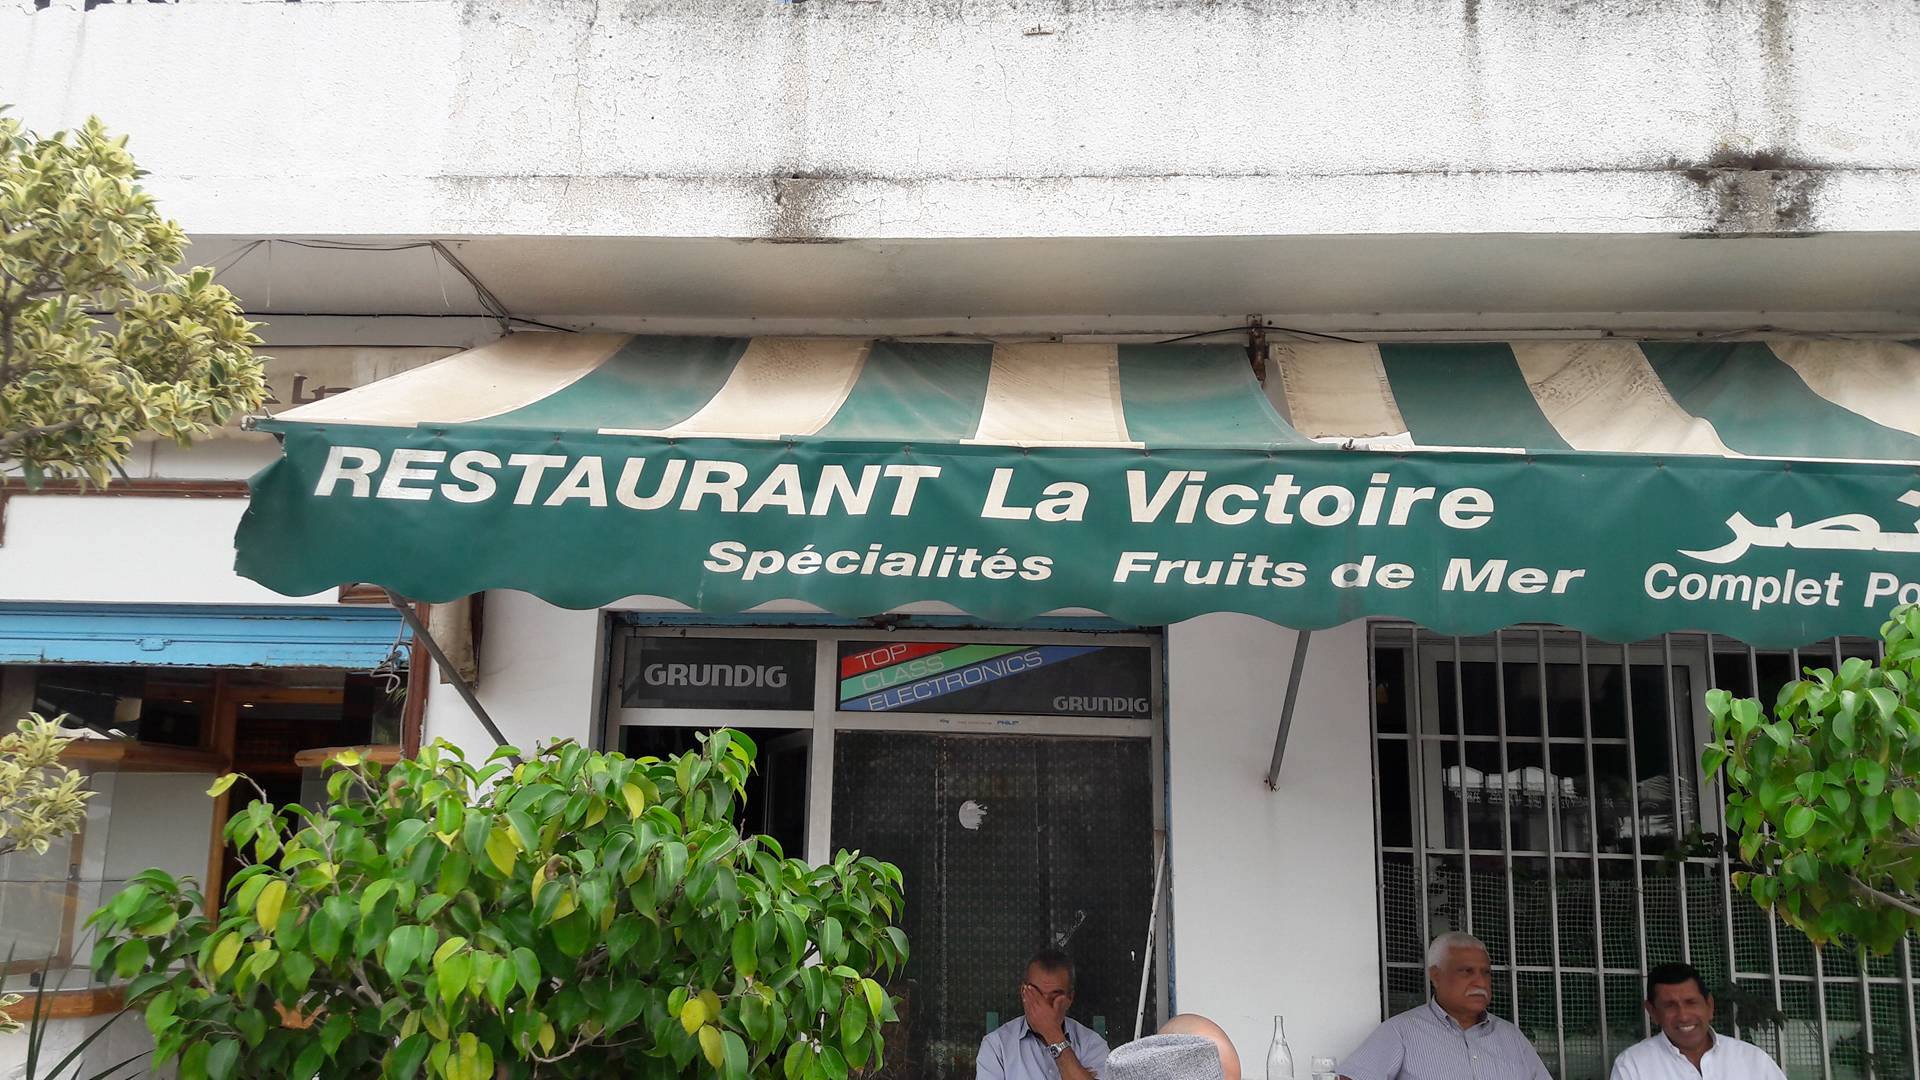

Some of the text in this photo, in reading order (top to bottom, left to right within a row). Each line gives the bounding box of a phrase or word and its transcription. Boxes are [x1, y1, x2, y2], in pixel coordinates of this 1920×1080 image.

[314, 445, 1495, 529] RESTAURANT La Victoire
[703, 540, 1586, 594] Spécialités Fruits de Mer
[1644, 562, 1844, 611] Complet
[644, 663, 787, 688] GRUNDIG
[856, 644, 907, 669] TOP
[862, 655, 944, 691] CLASS
[868, 651, 1043, 712] ELECTRONICS
[1053, 696, 1149, 713] GRUNDIG
